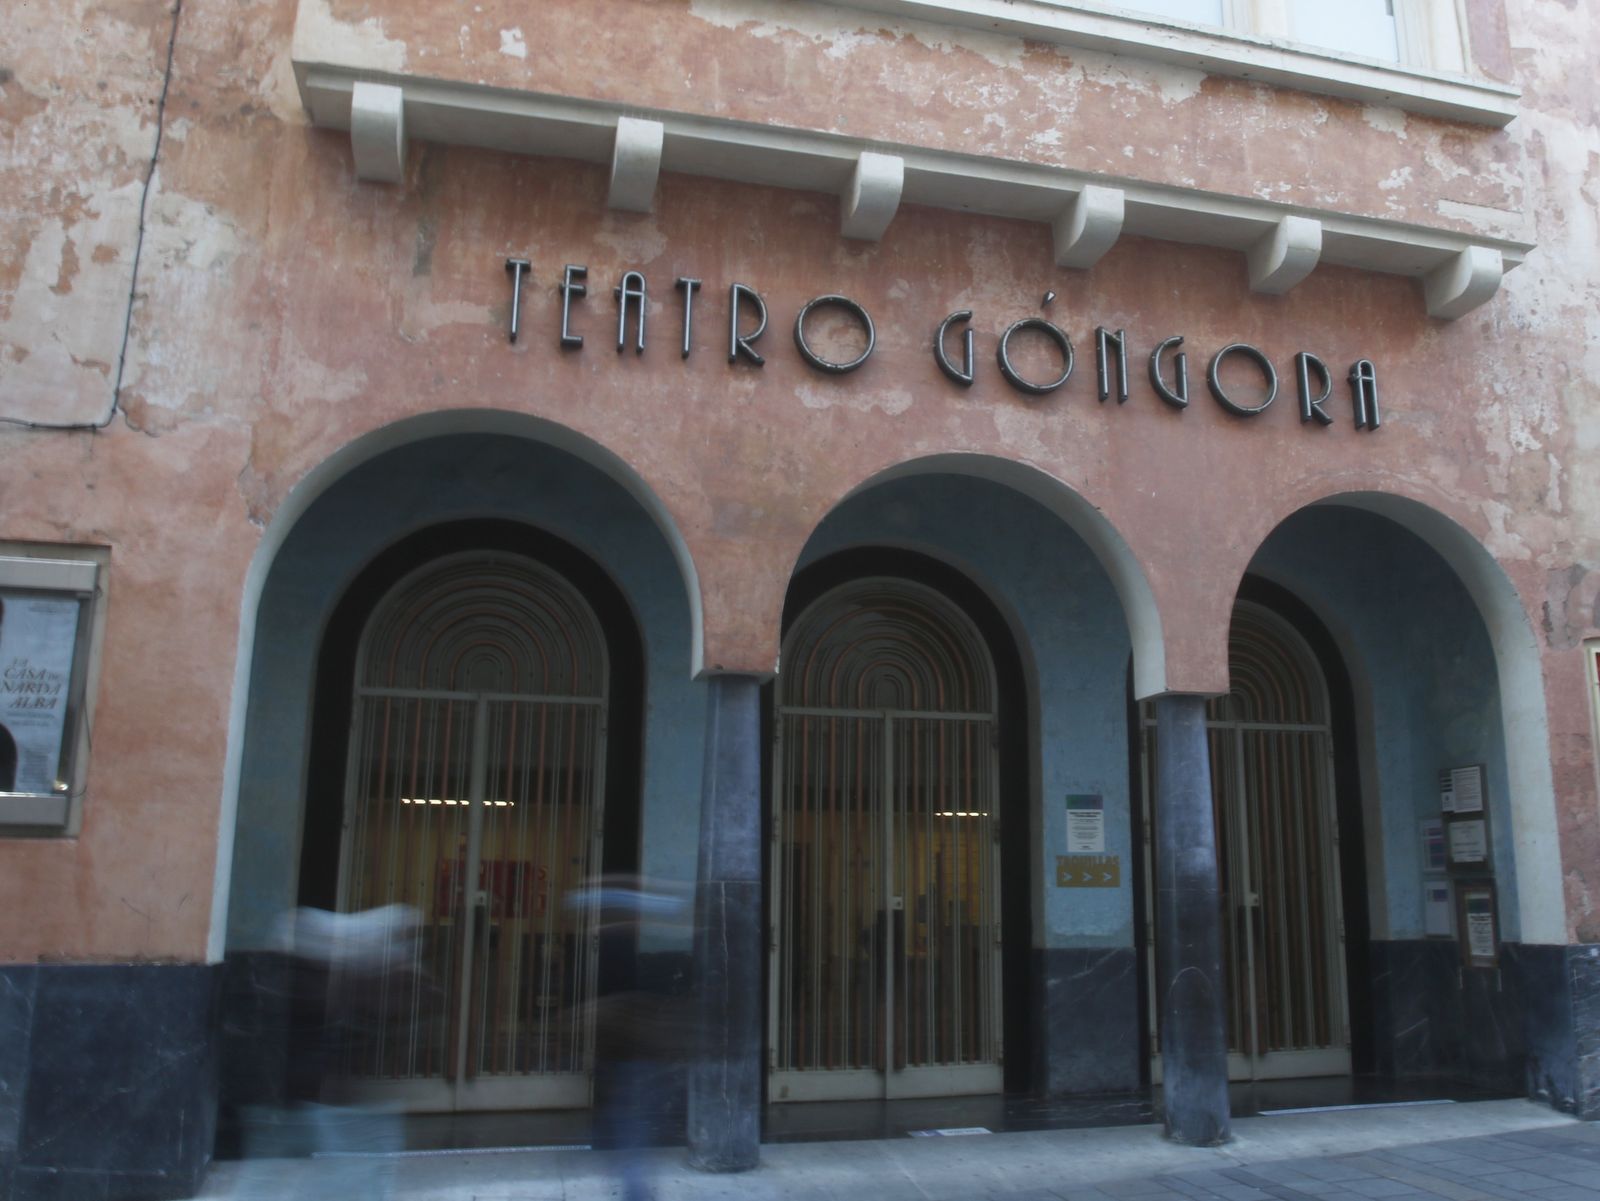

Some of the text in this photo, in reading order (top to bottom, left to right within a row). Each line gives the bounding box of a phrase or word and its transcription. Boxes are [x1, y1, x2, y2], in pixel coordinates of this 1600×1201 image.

[506, 257, 1382, 431] TEATRO GÓNGORA
[4, 668, 47, 680] CASA
[9, 697, 58, 709] ALBA
